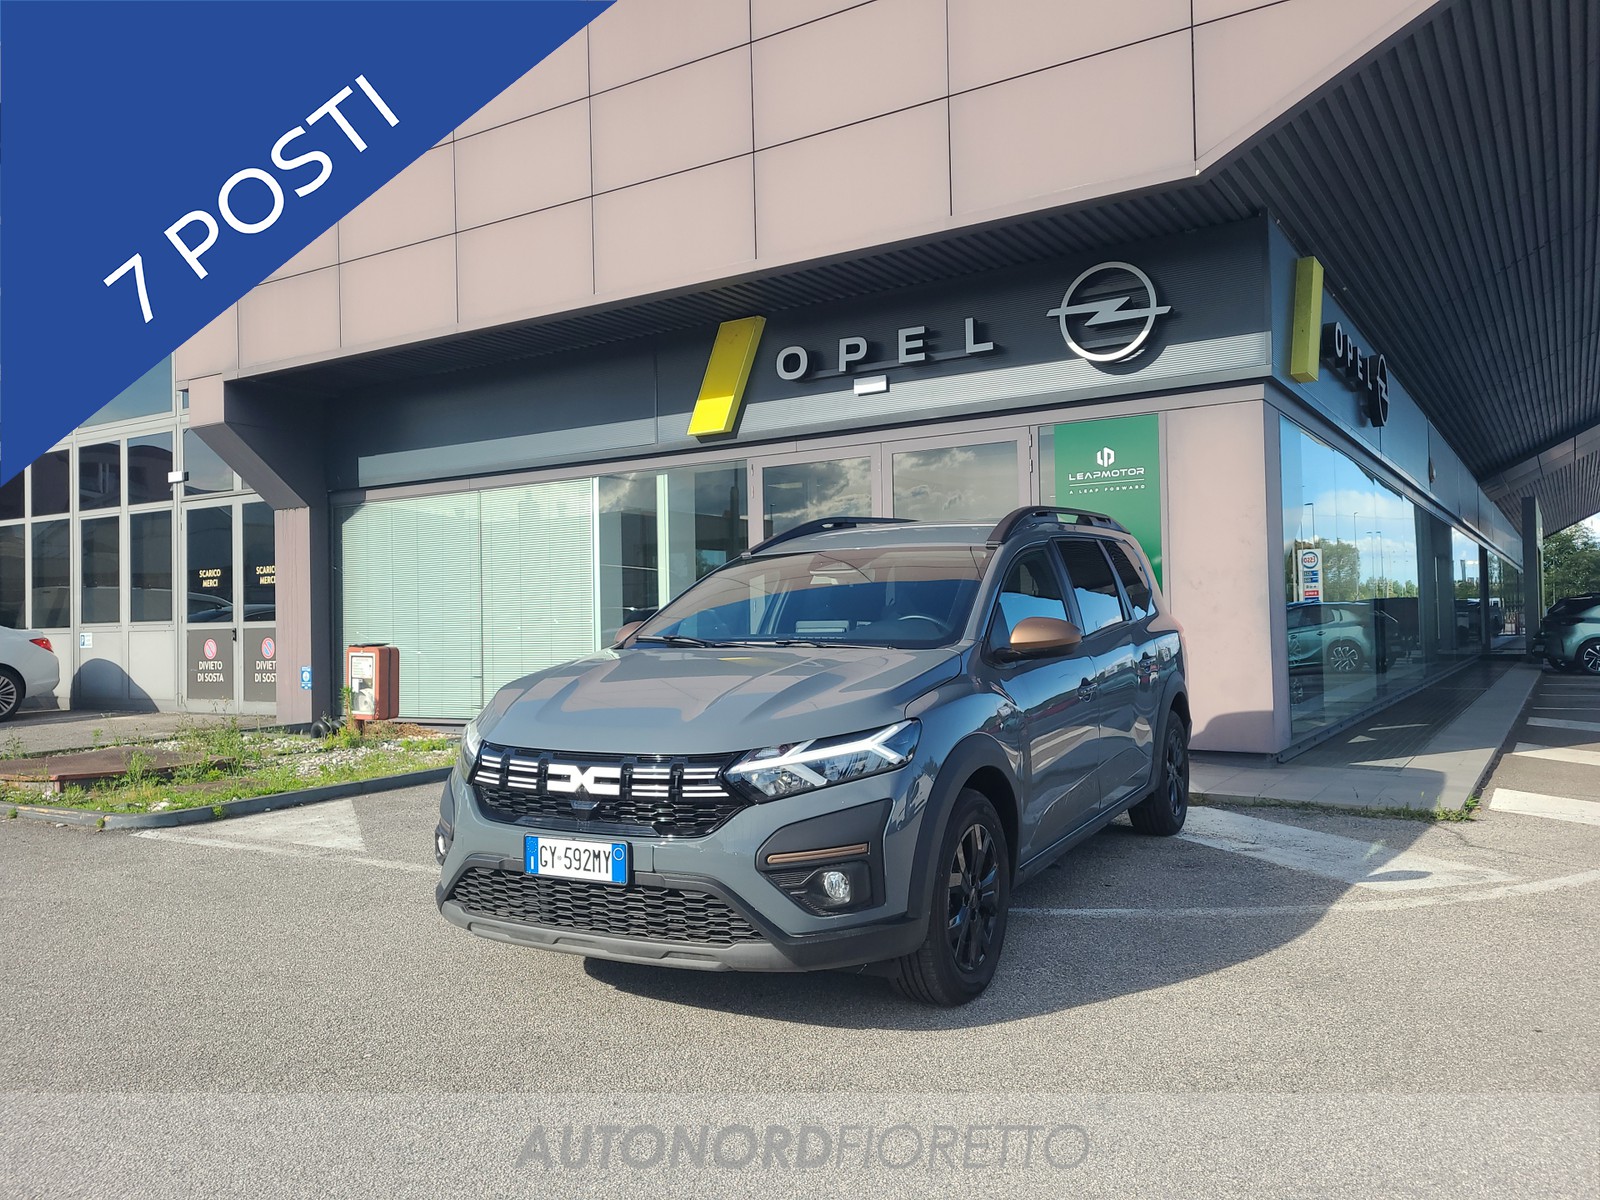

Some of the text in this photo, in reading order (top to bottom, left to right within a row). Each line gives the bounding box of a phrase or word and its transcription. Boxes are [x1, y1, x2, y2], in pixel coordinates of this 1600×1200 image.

[776, 317, 994, 380] OPEL
[1334, 321, 1373, 391] OPEL
[1068, 467, 1145, 481] LEAPMOTOR
[199, 569, 221, 578] SCARICO
[256, 565, 276, 575] SCARIC
[202, 579, 219, 587] MERCI
[198, 661, 223, 670] DIVIETO
[255, 660, 277, 670] DIVIET
[197, 672, 224, 682] DI SOSTA
[254, 672, 277, 683] DI SOST
